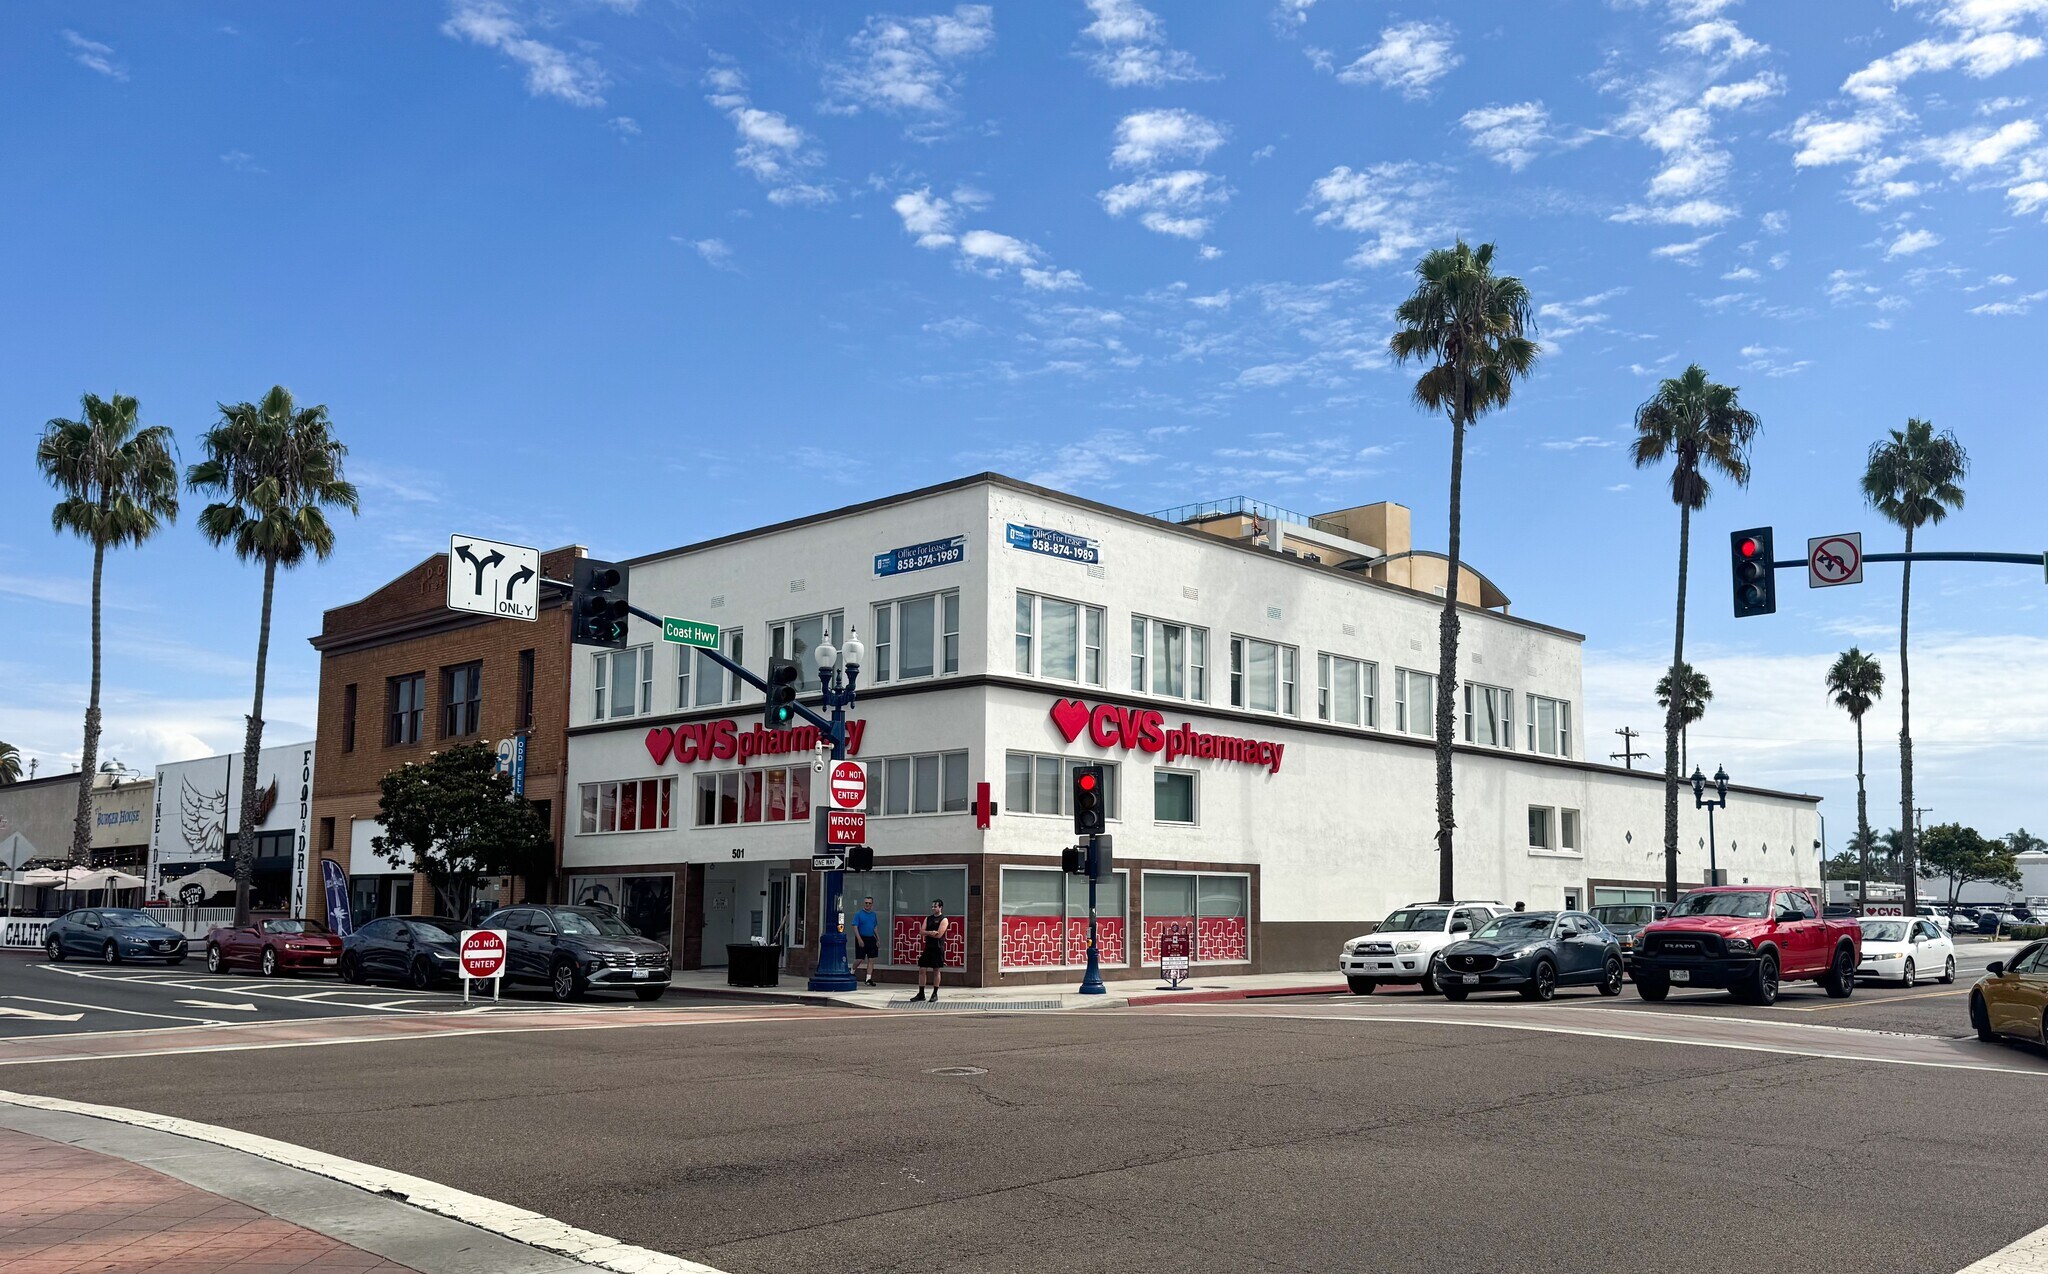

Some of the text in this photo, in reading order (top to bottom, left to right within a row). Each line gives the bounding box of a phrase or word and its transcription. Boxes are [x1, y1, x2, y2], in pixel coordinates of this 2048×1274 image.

[1032, 529, 1051, 541] Office
[1052, 533, 1064, 542] For
[1064, 535, 1082, 547] Lease
[897, 543, 946, 559] Office For Lease
[1032, 539, 1094, 561] 858-874-1989
[897, 548, 959, 571] 858-874-1989
[499, 601, 533, 616] ONLY
[666, 623, 716, 644] Coast Hwy
[673, 719, 867, 765] CVS pharmy
[1089, 704, 1285, 774] CVS pharmacy
[835, 769, 862, 779] DO NOT
[300, 750, 311, 820] FOOD
[155, 772, 164, 834] WINE
[837, 791, 859, 800] ENTER
[97, 810, 140, 826] BURGER HOUSE
[831, 816, 864, 826] WRONG
[837, 831, 857, 840] WAY
[732, 848, 745, 859] 501
[294, 835, 306, 923] DRINK
[181, 886, 202, 898] FLYING
[186, 894, 199, 905] PIG
[1877, 907, 1902, 916] CVS
[468, 939, 500, 948] DO NOT
[470, 960, 496, 969] ENTER
